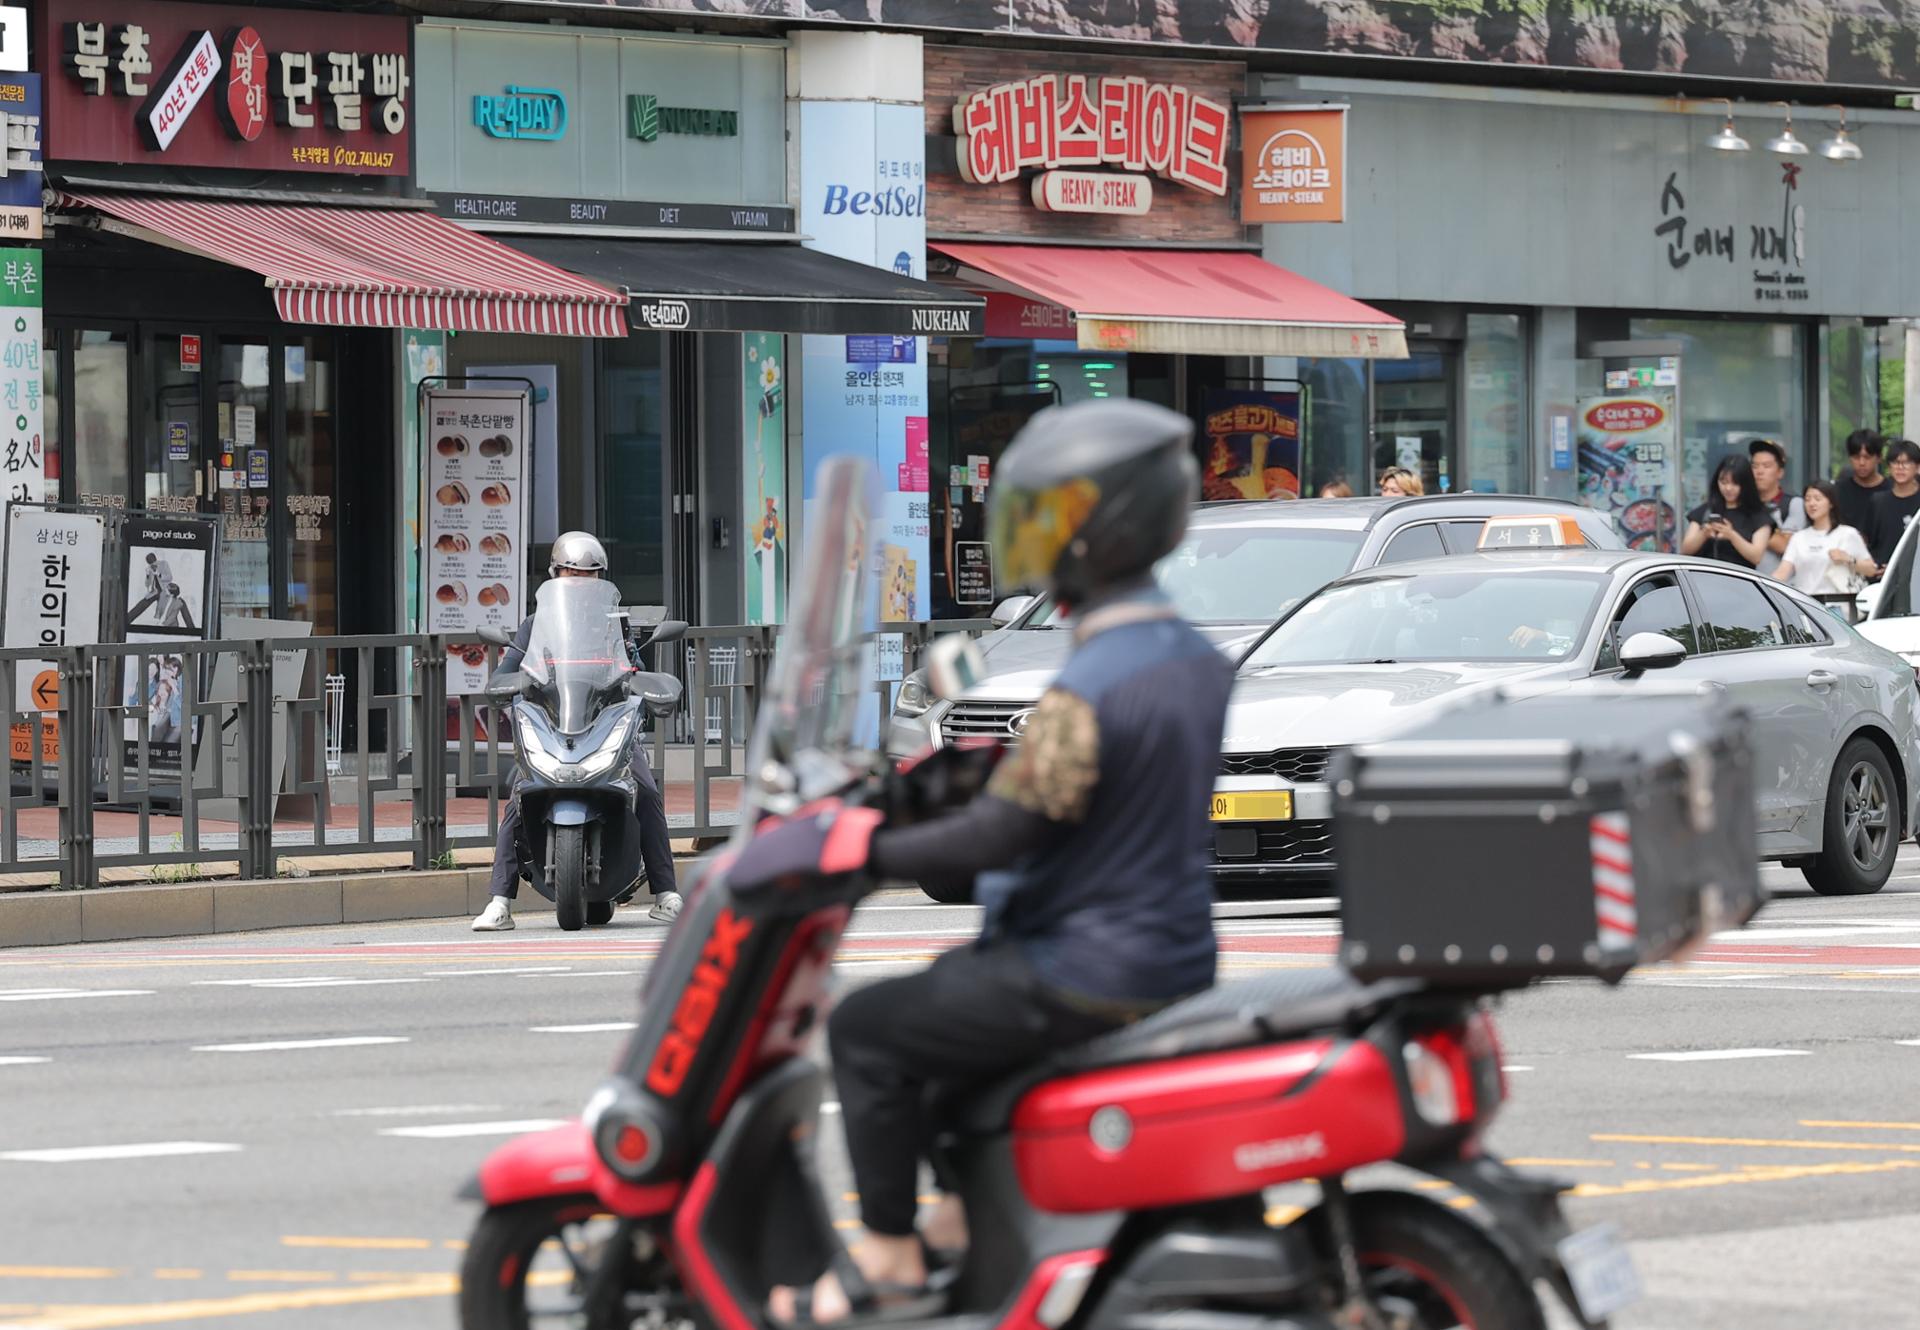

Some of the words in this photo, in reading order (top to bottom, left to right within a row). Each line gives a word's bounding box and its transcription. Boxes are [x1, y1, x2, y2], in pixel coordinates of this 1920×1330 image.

[74, 22, 151, 96] 북촌
[157, 87, 187, 135] 40년
[183, 43, 214, 94] 전통!
[232, 46, 262, 121] 명인
[279, 50, 410, 135] 단팥빵
[475, 92, 557, 132] RE4DAY
[657, 107, 738, 136] NUKHAN
[966, 73, 1229, 197] 헤비스테이크
[292, 147, 330, 164] 북촌직영점
[1271, 147, 1311, 167] 헤비
[1253, 168, 1330, 188] 스테이크
[823, 184, 923, 217] BestSel
[1061, 179, 1096, 205] HEAVY
[1103, 181, 1137, 208] STEAK
[454, 199, 491, 215] HEALTH
[492, 201, 517, 217] CARE
[570, 204, 607, 220] BEAUTY
[659, 207, 680, 223] DIET
[731, 211, 768, 227] VITAMIN
[4, 261, 37, 294] 북촌
[642, 301, 688, 328] RE4DAY
[912, 310, 970, 331] NUKHAN
[1021, 305, 1064, 327] 스테이크
[4, 338, 39, 370] 40년
[845, 371, 881, 387] 올인원
[4, 379, 41, 412] 전통
[4, 439, 38, 472] 名人
[36, 529, 79, 546] 삼선당
[142, 530, 163, 541] page
[164, 529, 172, 539] of
[173, 531, 196, 541] studio
[1498, 527, 1542, 545] 서울
